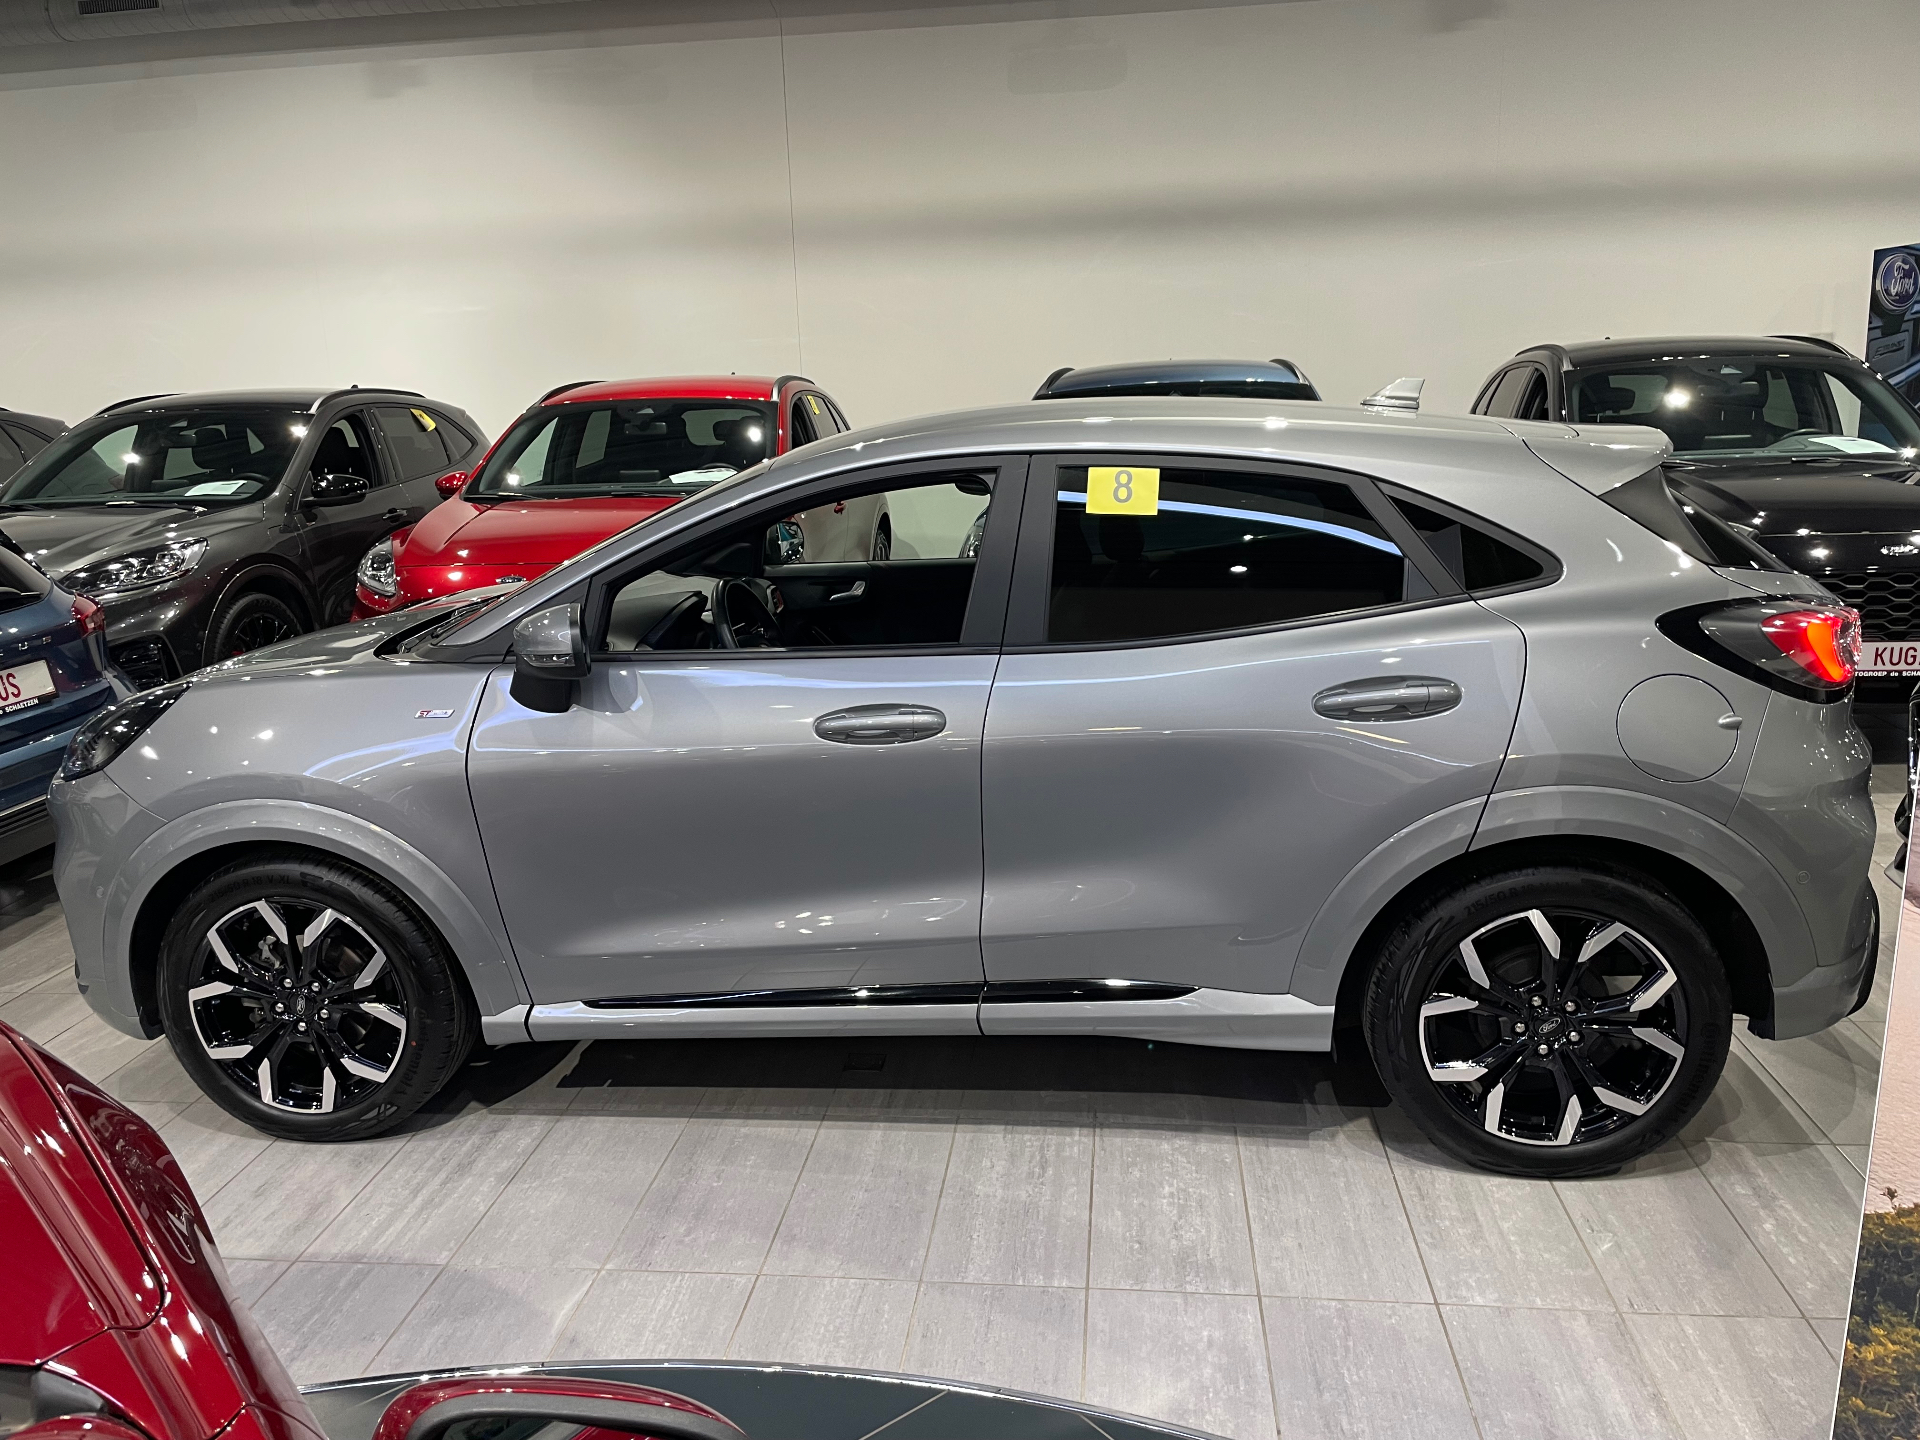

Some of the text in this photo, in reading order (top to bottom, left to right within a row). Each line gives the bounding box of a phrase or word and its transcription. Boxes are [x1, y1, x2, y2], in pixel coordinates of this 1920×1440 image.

[1890, 261, 1915, 296] Ford
[1113, 469, 1133, 504] 8
[1874, 647, 1920, 666] KUG
[5, 698, 39, 713] SCHAETZEN
[1463, 890, 1507, 916] 215/50
[1675, 1021, 1721, 1115] Continental
